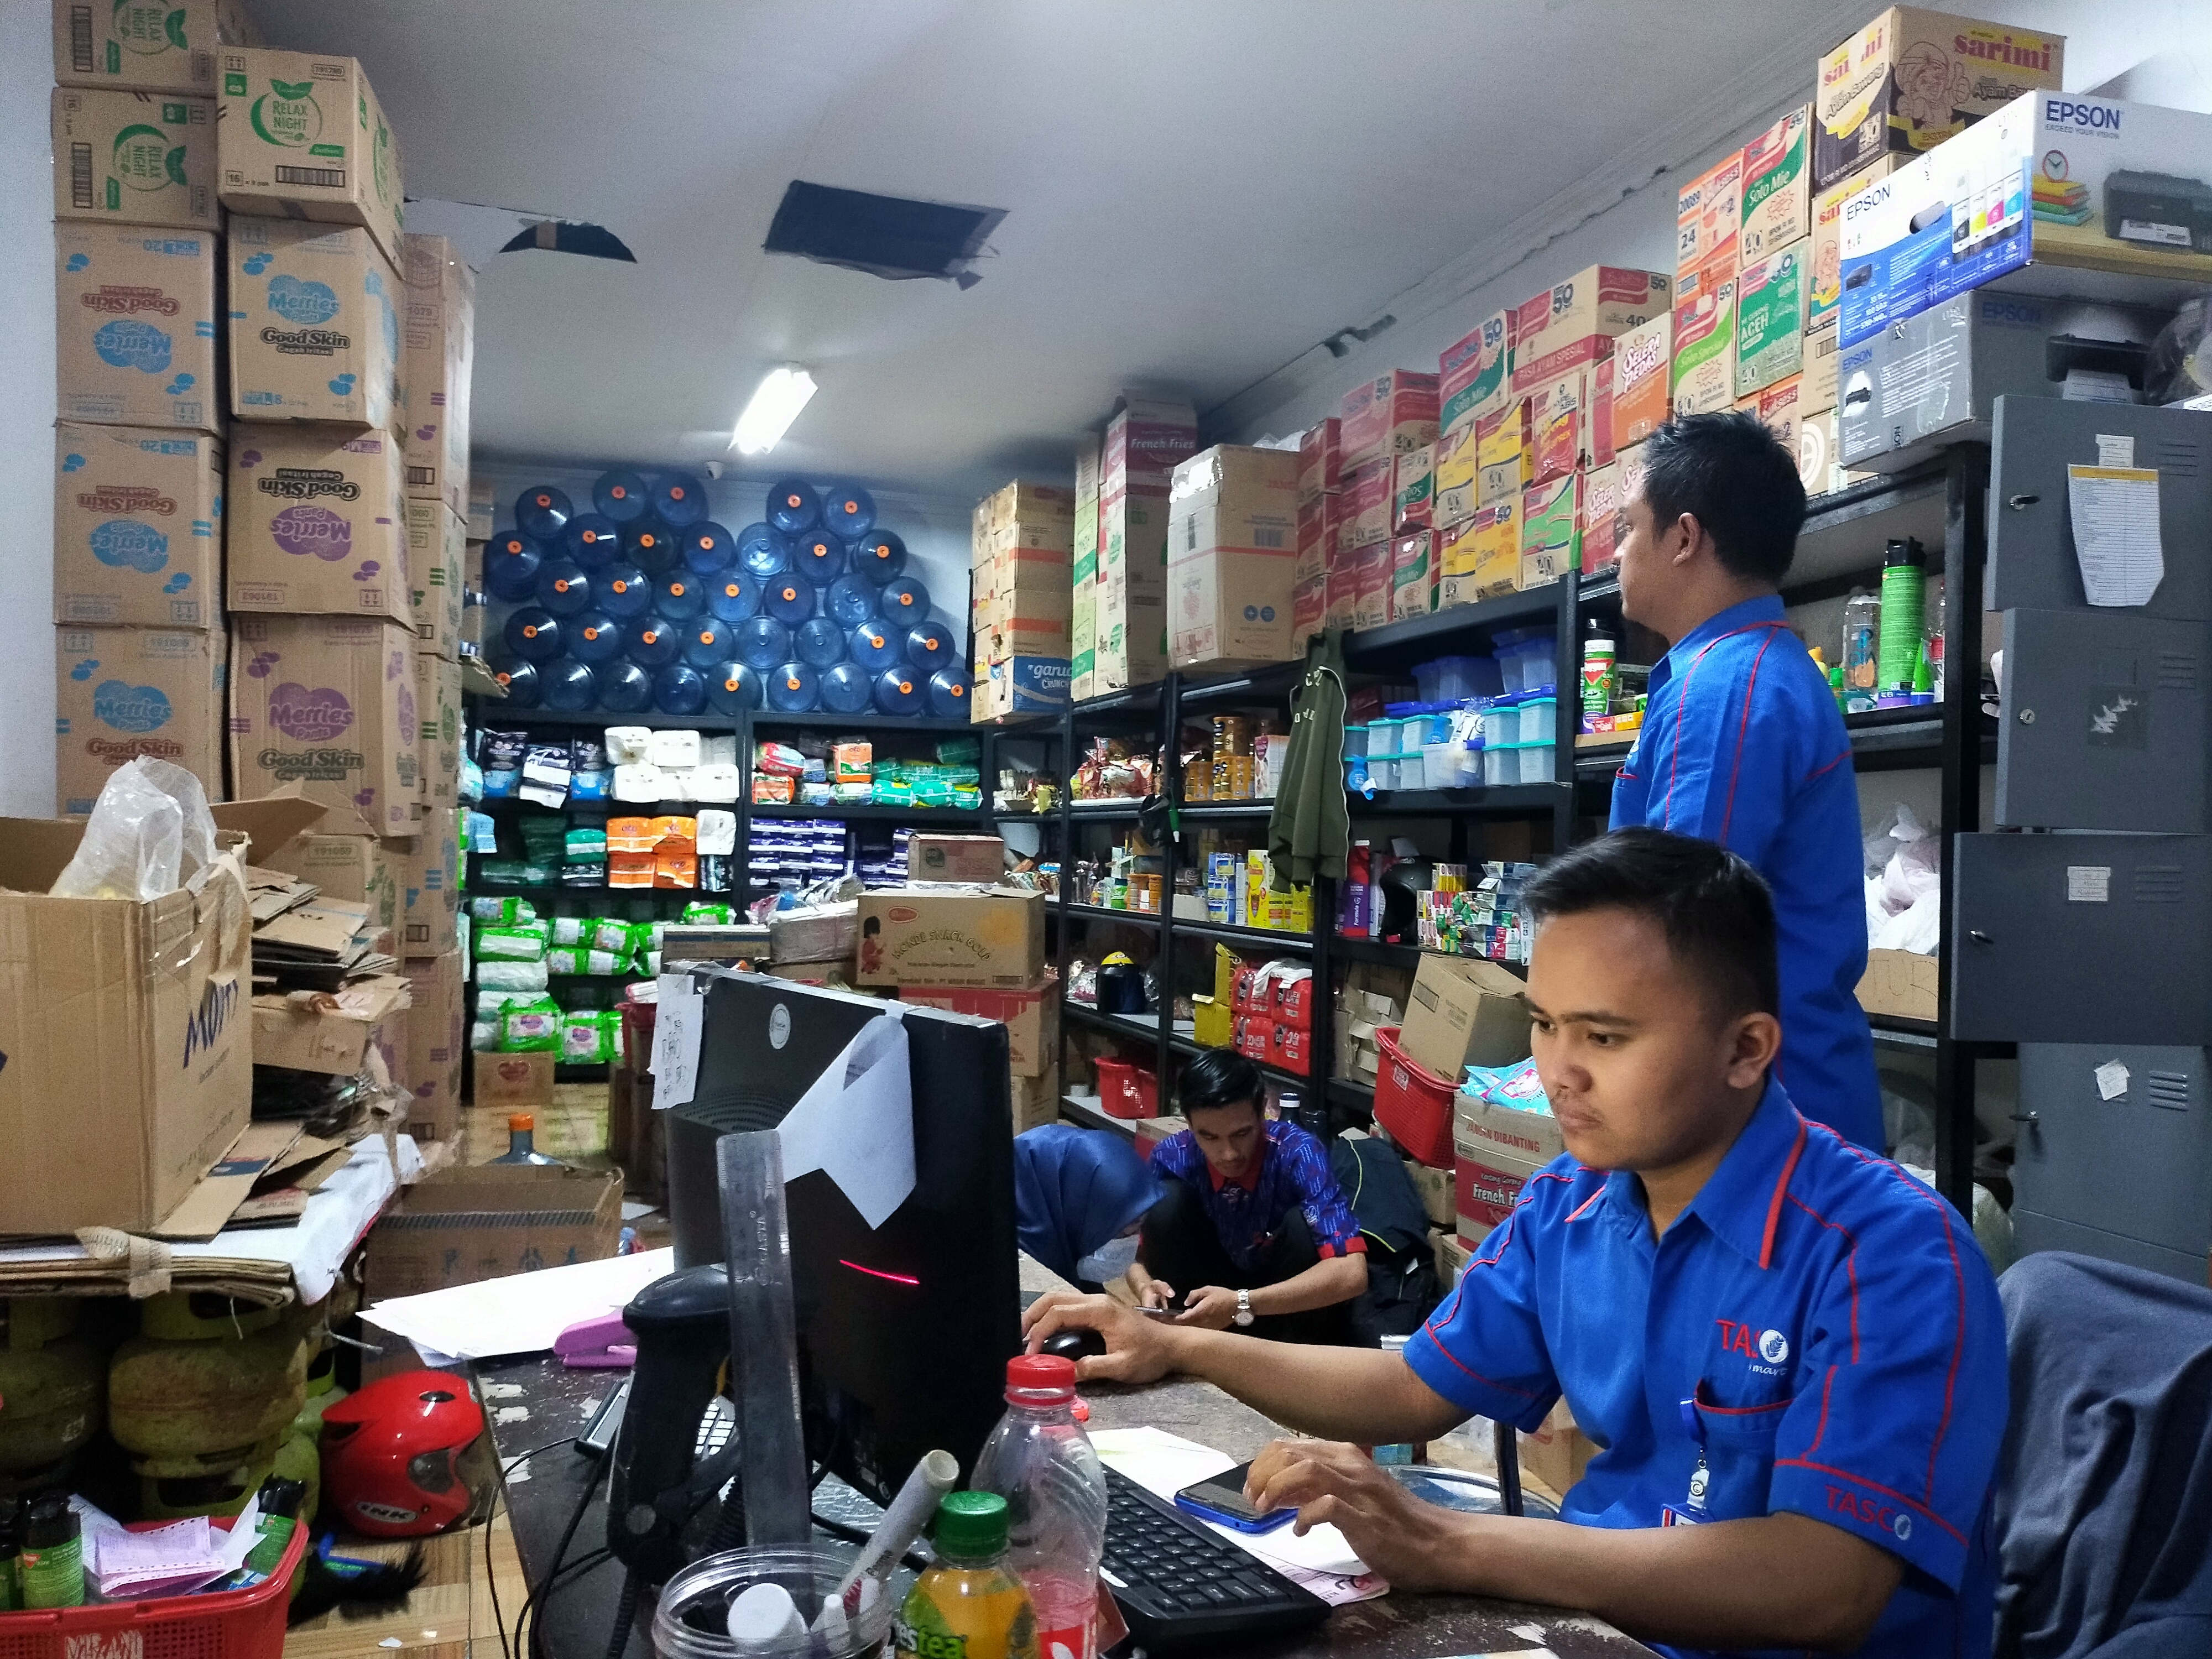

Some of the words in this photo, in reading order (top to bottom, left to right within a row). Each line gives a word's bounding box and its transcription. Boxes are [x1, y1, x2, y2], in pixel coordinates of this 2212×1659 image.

[1953, 34, 2051, 72] sarimi
[273, 100, 308, 116] RELAX
[2046, 100, 2120, 131] EPSON
[273, 117, 308, 131] NIGHT
[2046, 124, 2074, 134] EXCEED
[2076, 127, 2095, 137] YOUR
[2096, 128, 2120, 140] VISION
[229, 174, 240, 184] 16
[1847, 184, 1891, 222] EPSON
[1681, 227, 1697, 251] 24
[1651, 277, 1667, 291] 50
[269, 293, 340, 312] Merries
[1553, 284, 1573, 314] 50
[1626, 314, 1646, 327] 40
[1981, 300, 2041, 324] EPSON
[261, 327, 309, 345] Good
[308, 331, 351, 349] Skin
[1483, 318, 1503, 348] 50
[1740, 313, 1770, 343] ACEH
[1624, 332, 1661, 371] SELERA
[1843, 347, 1874, 371] EPSON
[1622, 348, 1659, 393] PEDAS
[1130, 437, 1167, 450] French
[1169, 437, 1194, 450] Fries
[259, 478, 307, 499] Skin
[307, 481, 361, 501] Good
[271, 518, 352, 542] Merries
[269, 701, 355, 727] Merries
[258, 748, 314, 769] Good
[314, 750, 365, 770] Skin
[930, 930, 966, 945] SNACK
[965, 937, 992, 963] GOLD
[1494, 1130, 1541, 1153] DIBANTING
[1473, 1182, 1505, 1206] French
